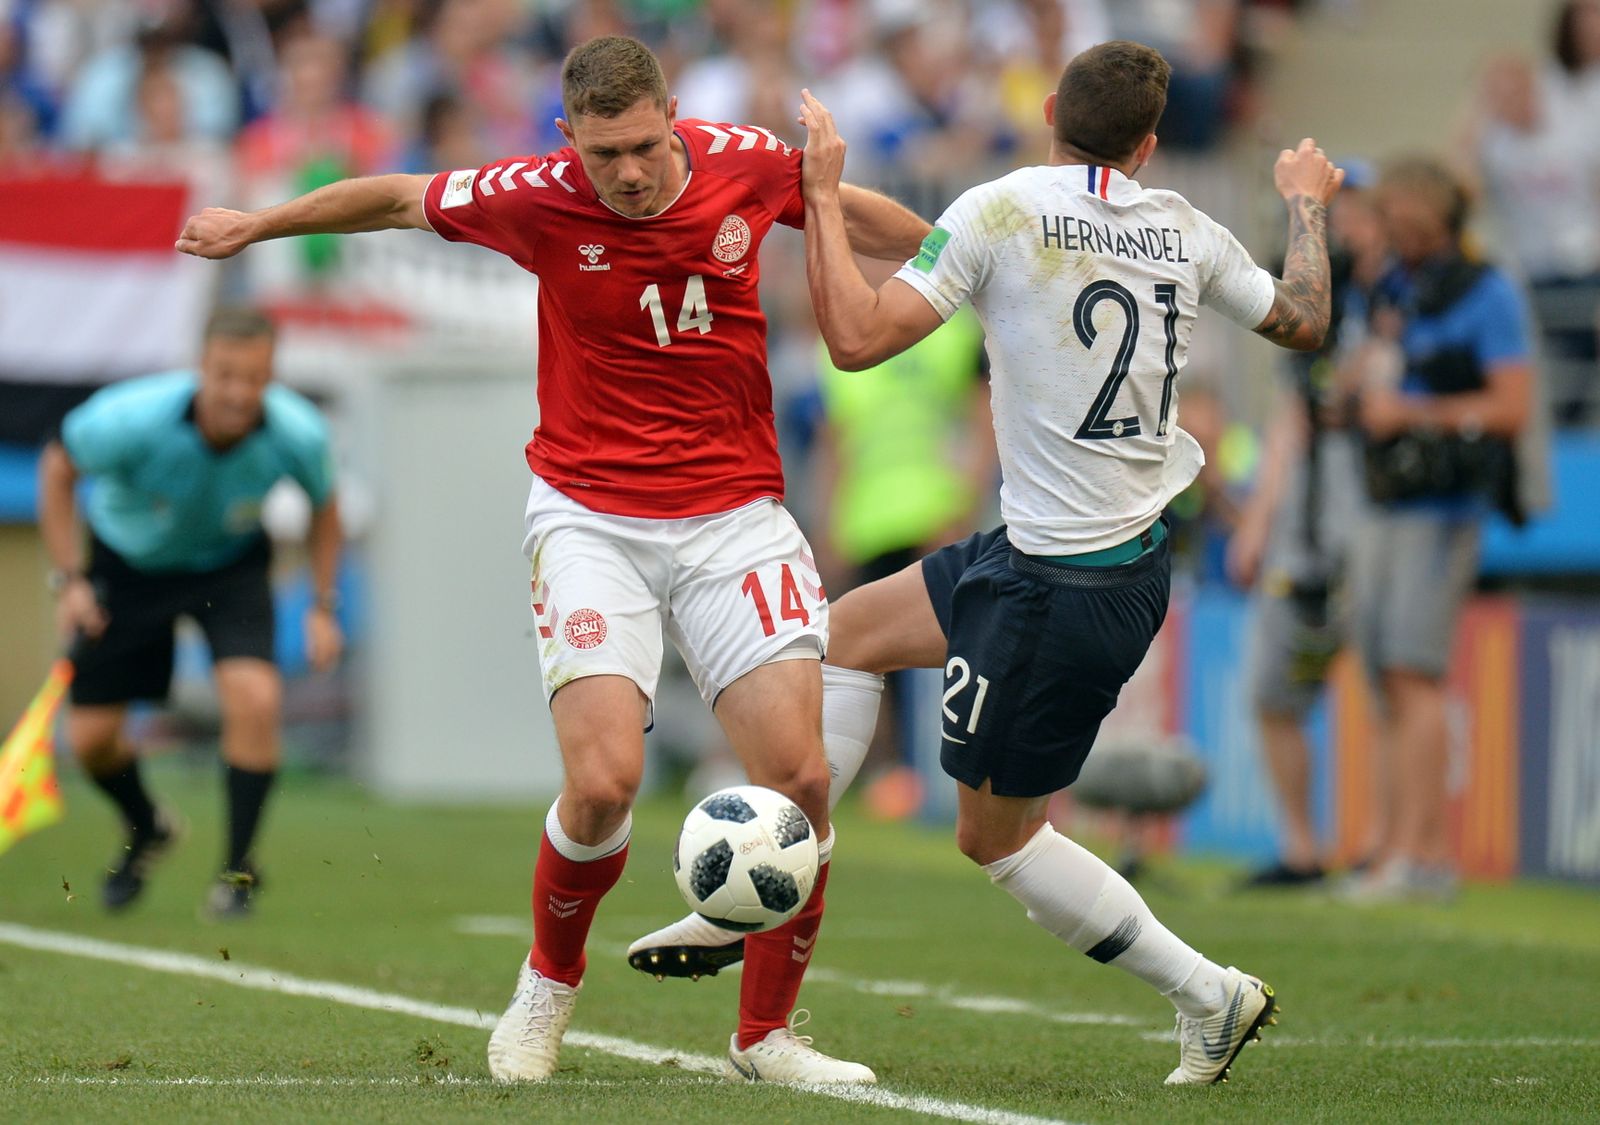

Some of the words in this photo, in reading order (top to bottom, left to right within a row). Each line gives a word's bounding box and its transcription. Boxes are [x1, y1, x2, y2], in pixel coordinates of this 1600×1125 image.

[579, 262, 611, 271] hummel
[719, 229, 742, 247] DBU
[1041, 214, 1189, 263] HERNANDEZ
[639, 274, 713, 348] 14
[1072, 279, 1180, 440] 21
[572, 620, 600, 638] DBU
[741, 563, 810, 638] 14
[942, 656, 989, 735] 21
